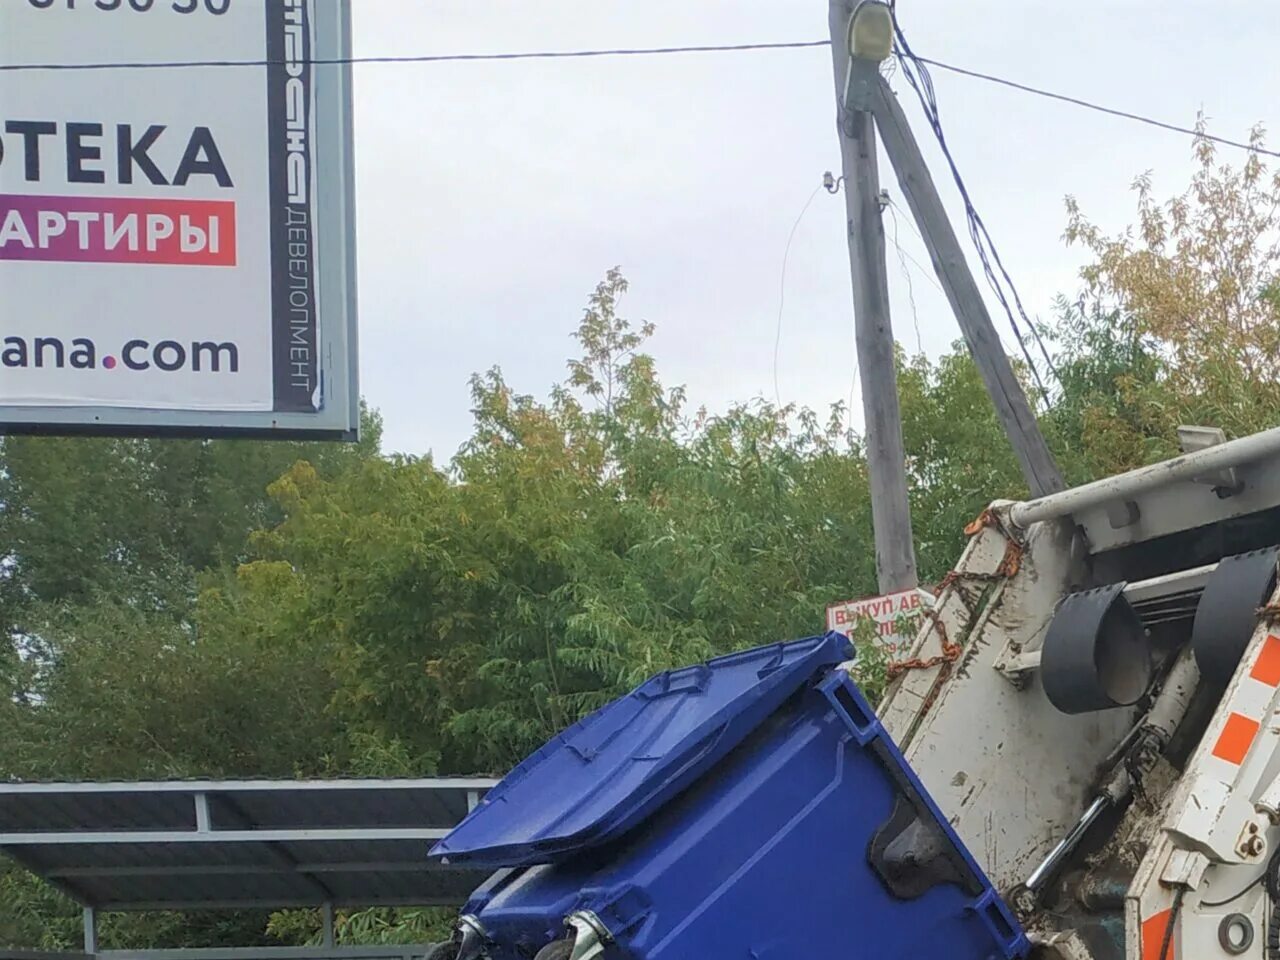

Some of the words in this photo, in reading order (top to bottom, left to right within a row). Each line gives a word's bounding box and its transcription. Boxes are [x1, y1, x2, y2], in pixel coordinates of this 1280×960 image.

[0, 120, 234, 188] ТЕКА
[285, 206, 311, 392] ДЕВЕЛОПМЕНТ
[2, 335, 239, 373] ana.com
